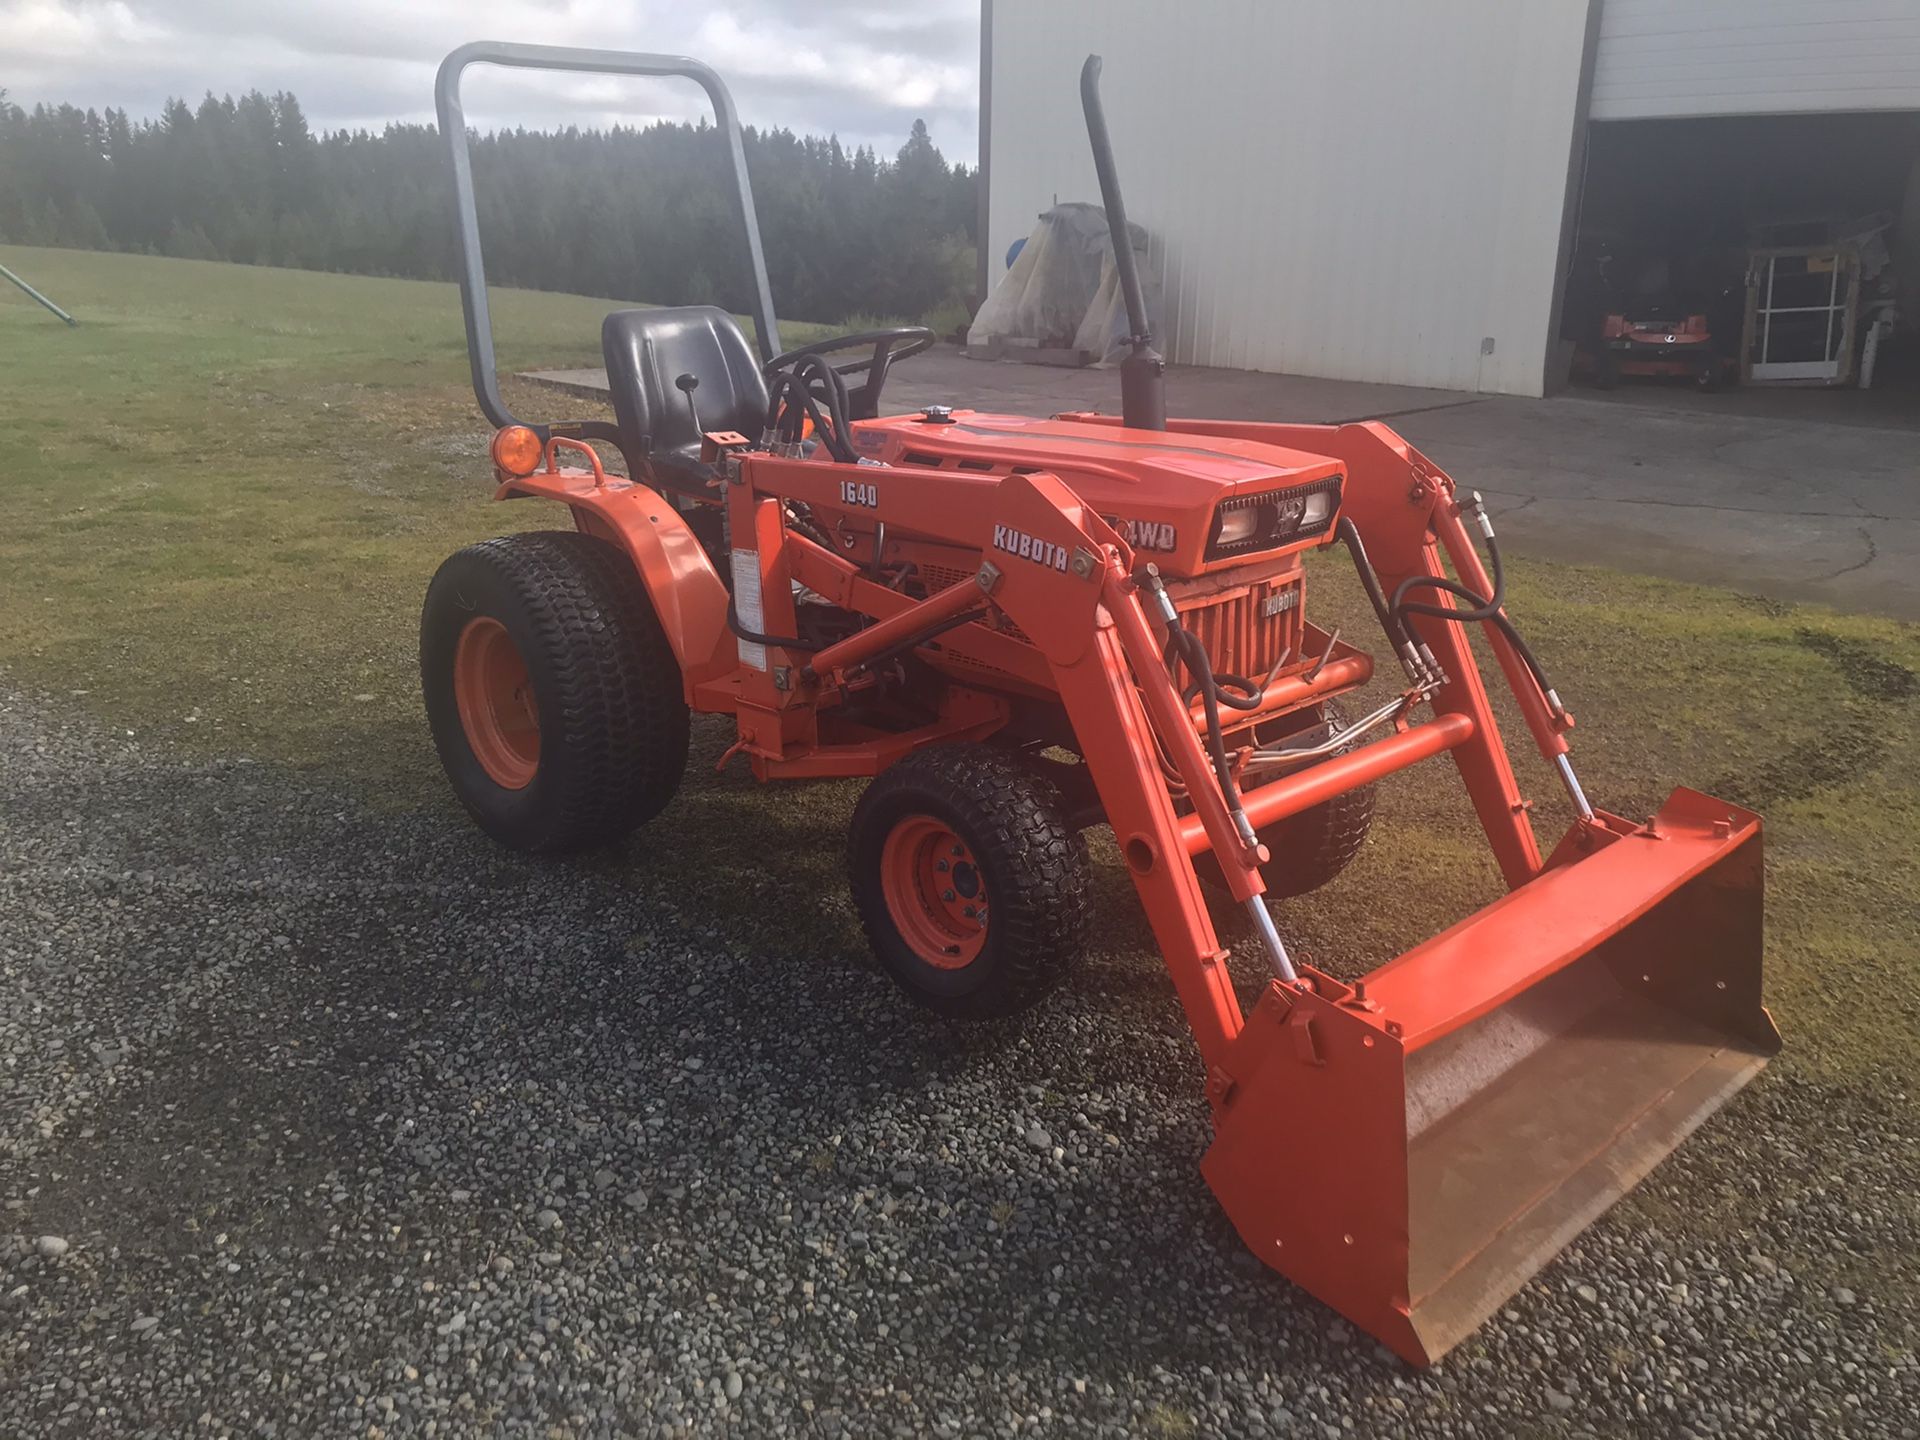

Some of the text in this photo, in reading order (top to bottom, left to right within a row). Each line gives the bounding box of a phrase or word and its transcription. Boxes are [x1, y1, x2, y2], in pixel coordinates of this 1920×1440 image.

[840, 480, 878, 508] 1640
[994, 524, 1068, 573] KUBOTA
[1123, 520, 1177, 552] 4WD
[1265, 591, 1299, 617] KUBOTA
